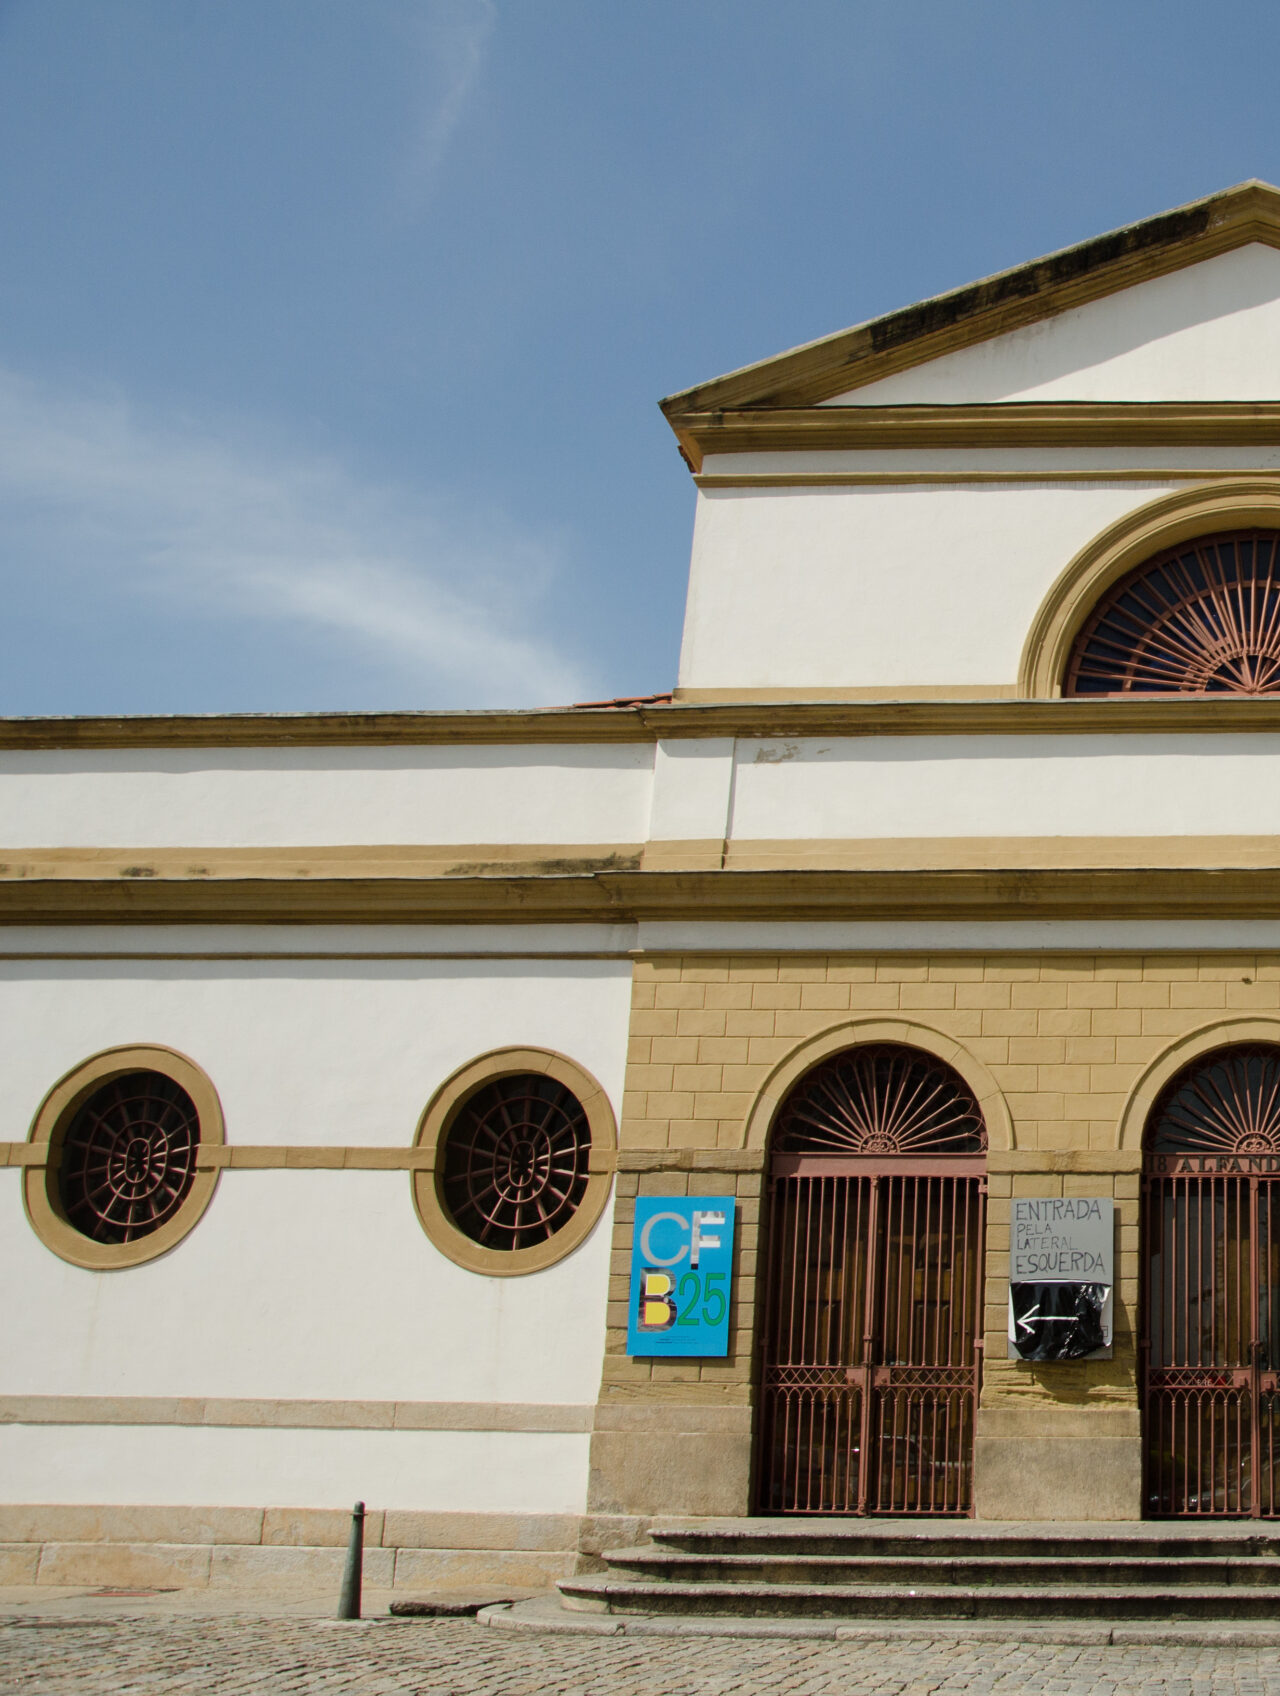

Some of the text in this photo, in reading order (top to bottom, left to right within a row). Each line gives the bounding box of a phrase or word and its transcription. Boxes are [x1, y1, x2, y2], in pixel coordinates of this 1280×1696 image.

[1015, 1199, 1102, 1221] ENTRADA
[640, 1210, 726, 1269] CF
[1016, 1223, 1052, 1238] PELA
[1016, 1236, 1078, 1250] LATERAL
[1015, 1251, 1107, 1275] ESQUERDA
